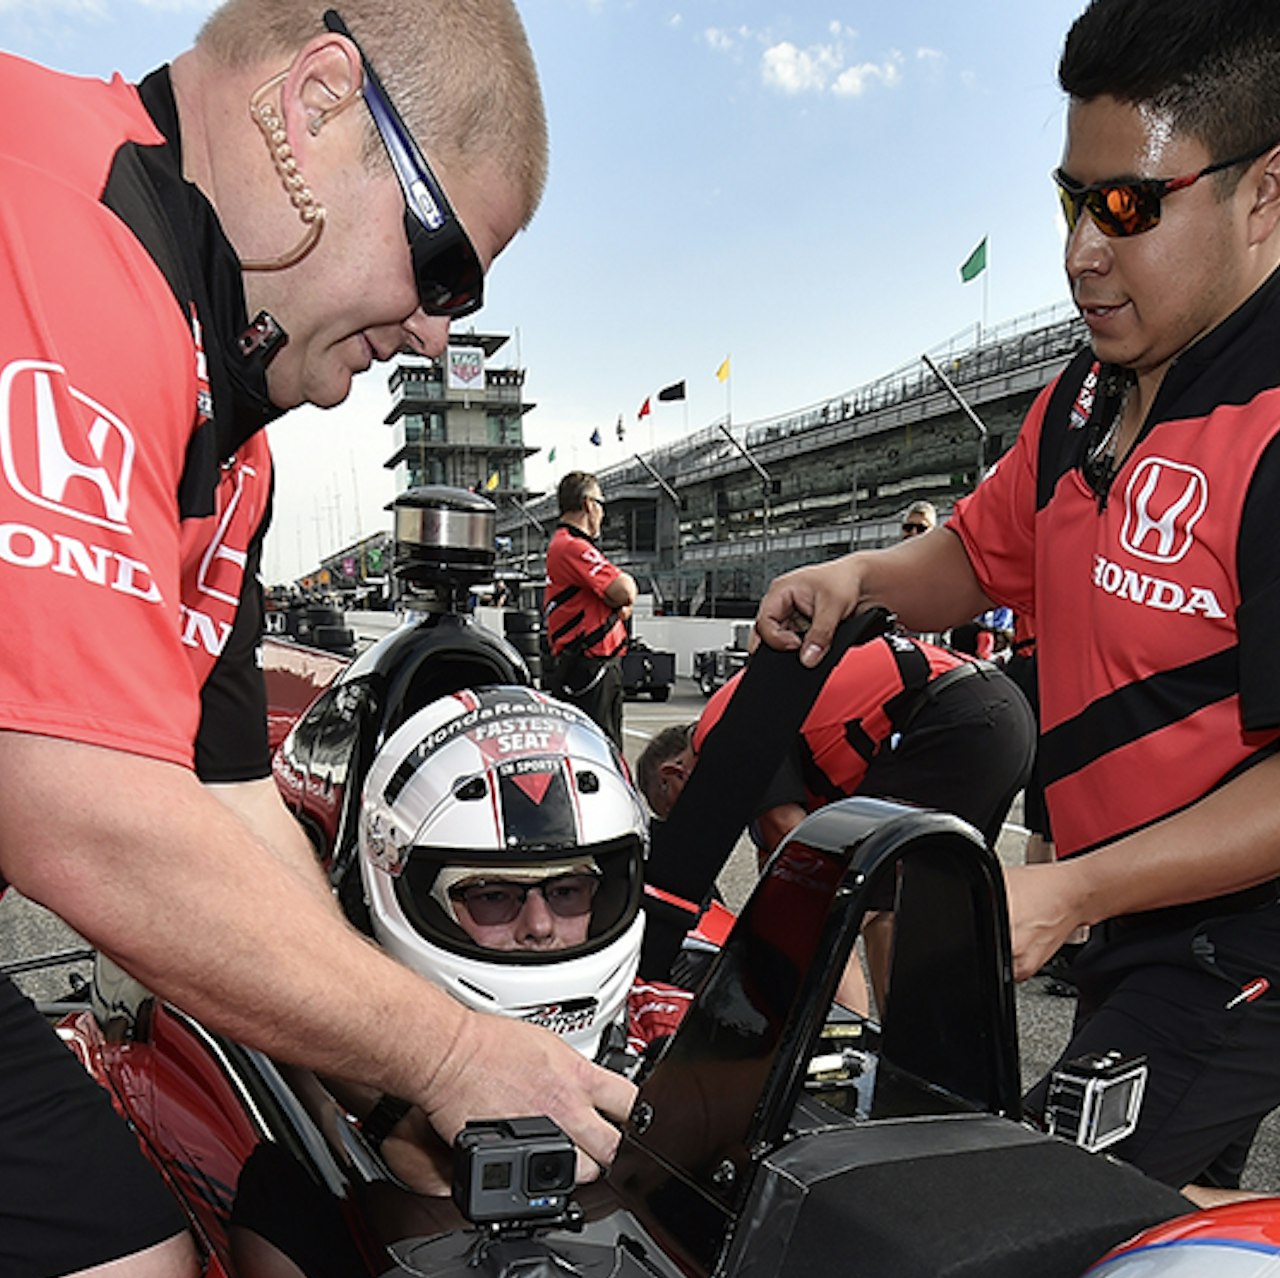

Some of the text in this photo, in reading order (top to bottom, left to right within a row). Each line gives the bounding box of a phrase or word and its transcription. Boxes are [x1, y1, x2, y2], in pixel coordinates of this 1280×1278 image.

[416, 702, 578, 758] HondaRacing
[475, 716, 567, 742] FASTEST
[497, 732, 552, 754] SEAT
[515, 759, 561, 776] SPORTS
